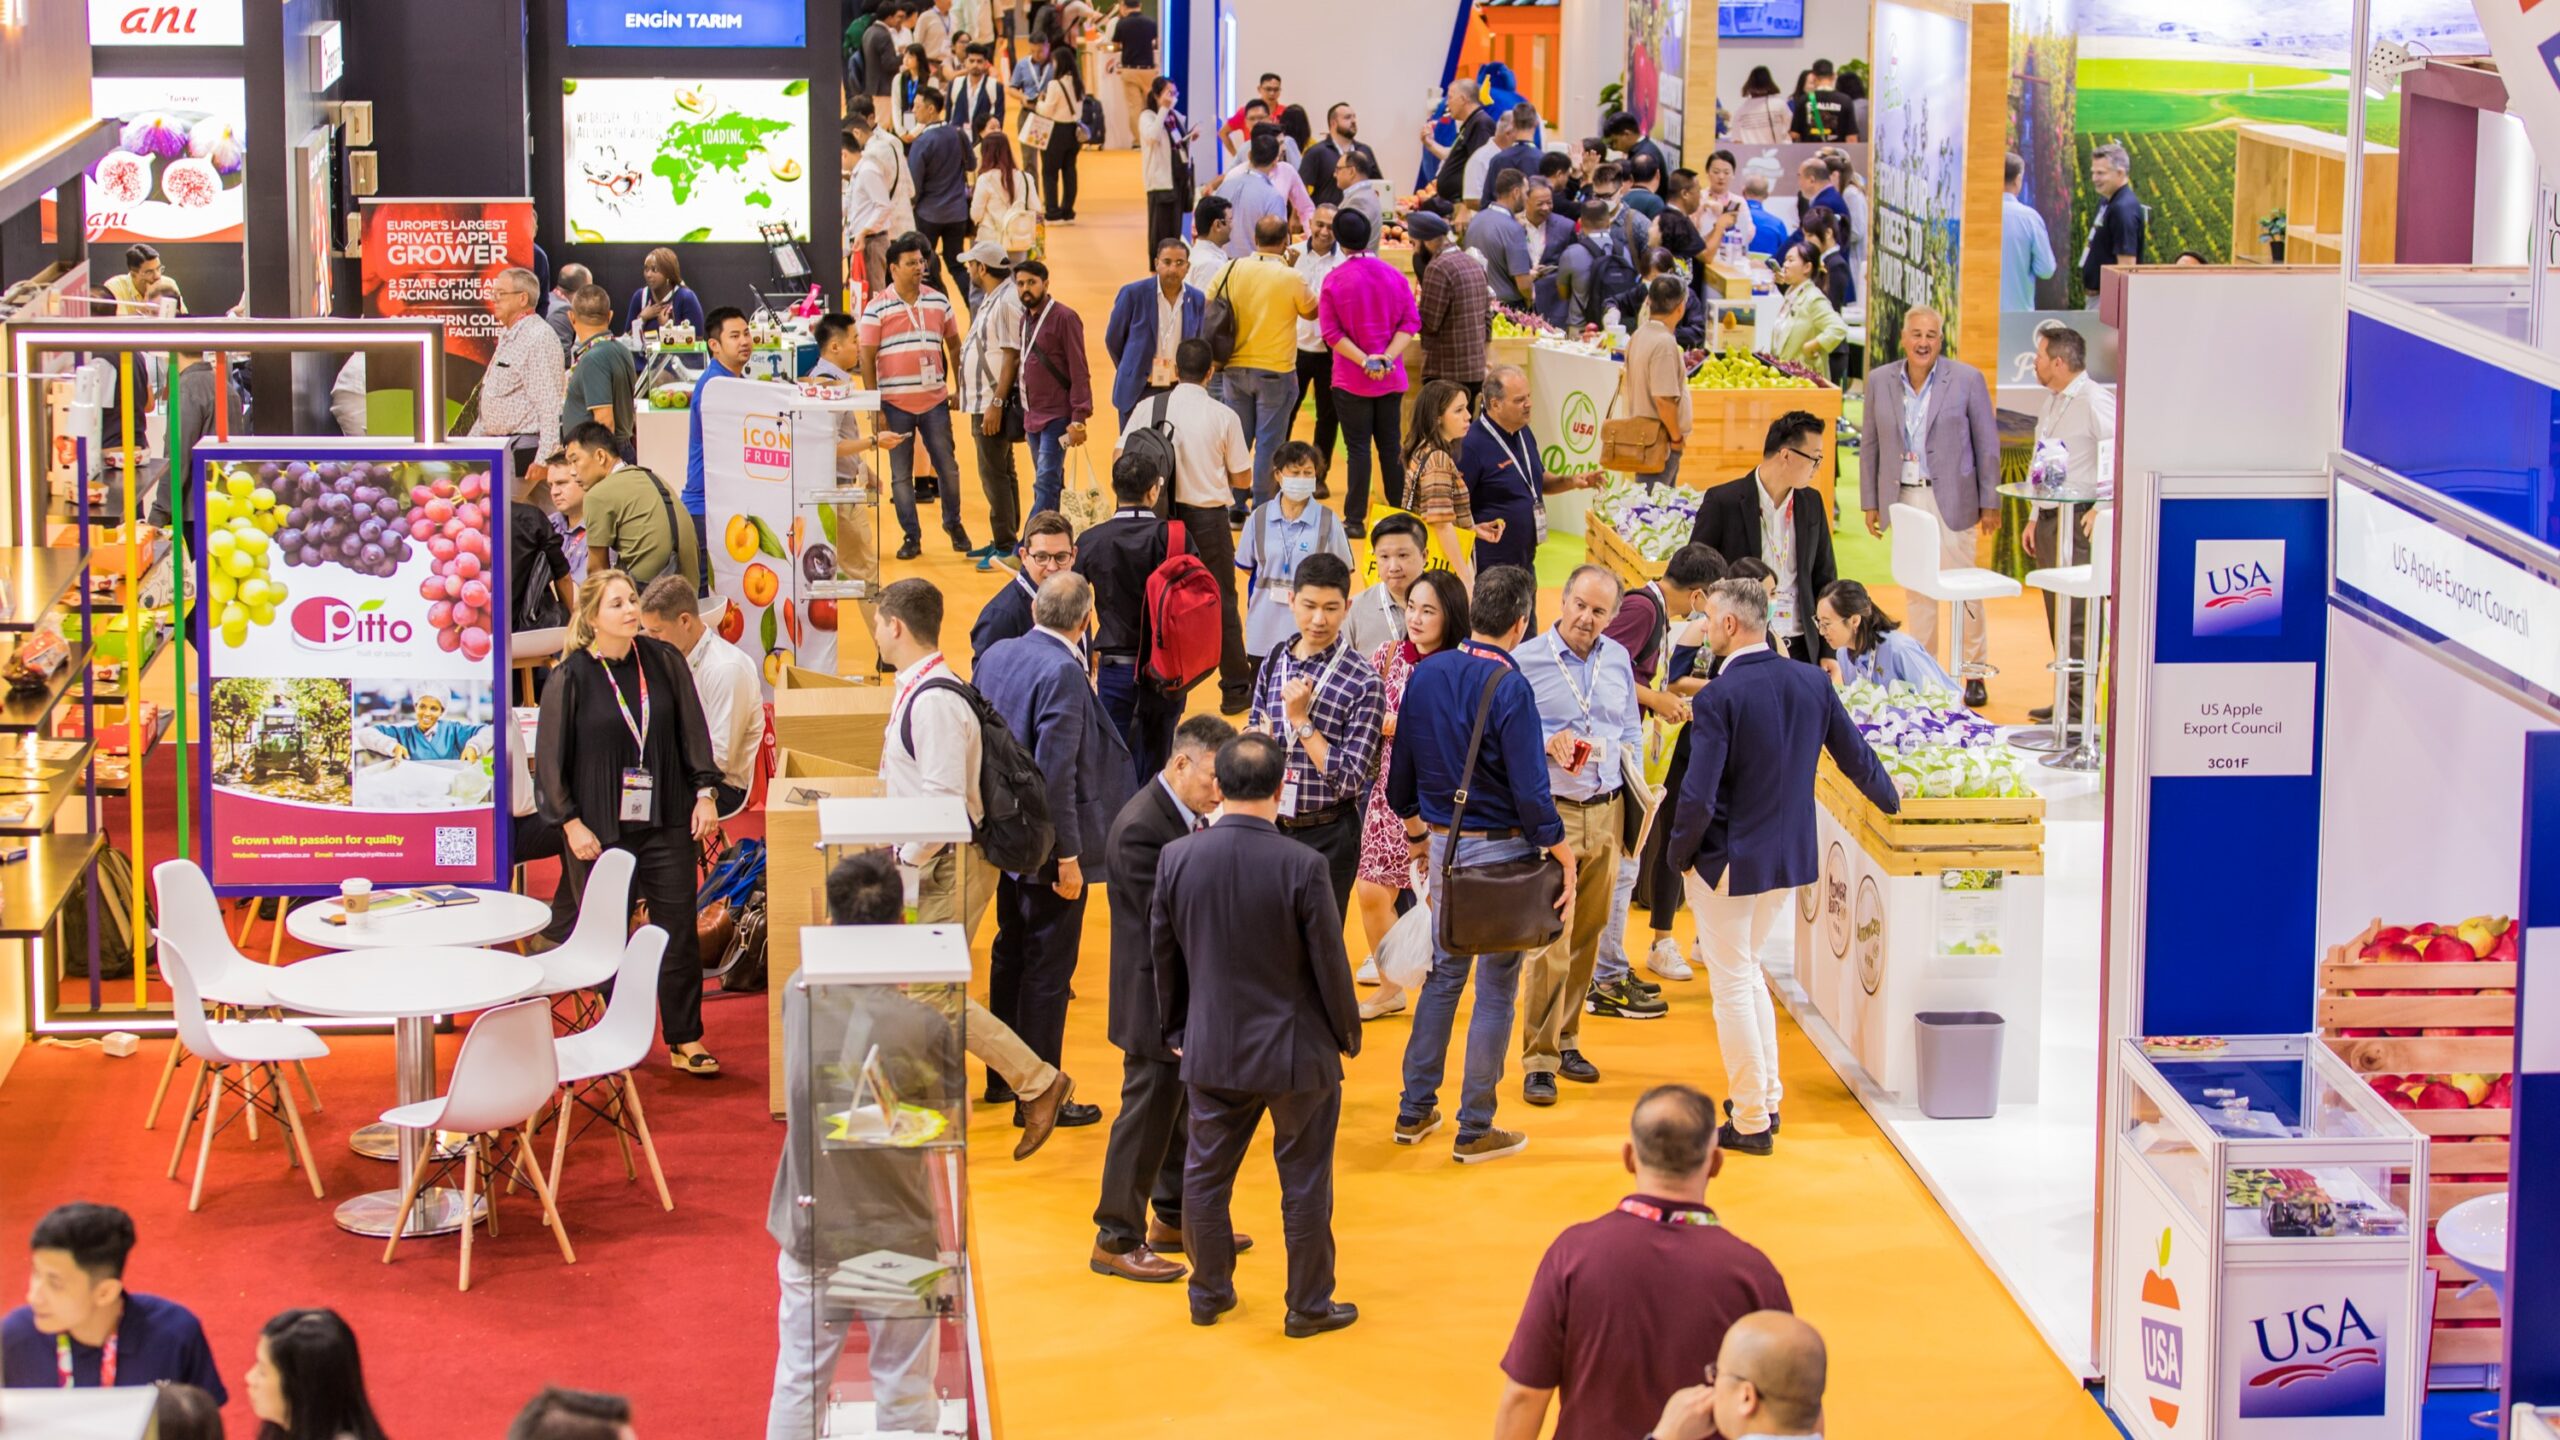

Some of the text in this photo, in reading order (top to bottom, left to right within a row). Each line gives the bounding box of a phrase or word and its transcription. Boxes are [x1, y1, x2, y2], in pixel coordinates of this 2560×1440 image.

[625, 10, 742, 29] ENGİN TARIM
[1879, 161, 1928, 221] FROM OUR
[386, 220, 508, 231] EUROPE'S LARGEST
[386, 232, 508, 244] PRIVATE APPLE
[1879, 205, 1923, 265] TREES TO
[387, 245, 508, 265] GROWER
[388, 279, 397, 289] 2
[398, 278, 437, 289] STATE
[438, 278, 456, 289] OF
[457, 278, 482, 289] THE
[1878, 250, 1904, 300] YOUR
[388, 289, 495, 301] PACKING HOUS
[470, 314, 504, 325] COL
[448, 327, 505, 337] FACILITIE
[1572, 421, 1595, 436] USA
[743, 427, 791, 449] ICON
[745, 449, 790, 466] FRUIT
[2205, 560, 2273, 596] USA
[2392, 542, 2530, 638] US Apple Export Council
[2200, 703, 2263, 719] US Apple
[2183, 721, 2282, 738] Export Council
[2207, 757, 2250, 769] 3C01F
[232, 834, 404, 846] Grown with passion for quality
[2248, 1297, 2381, 1363] USA
[2143, 1325, 2181, 1383] USA
